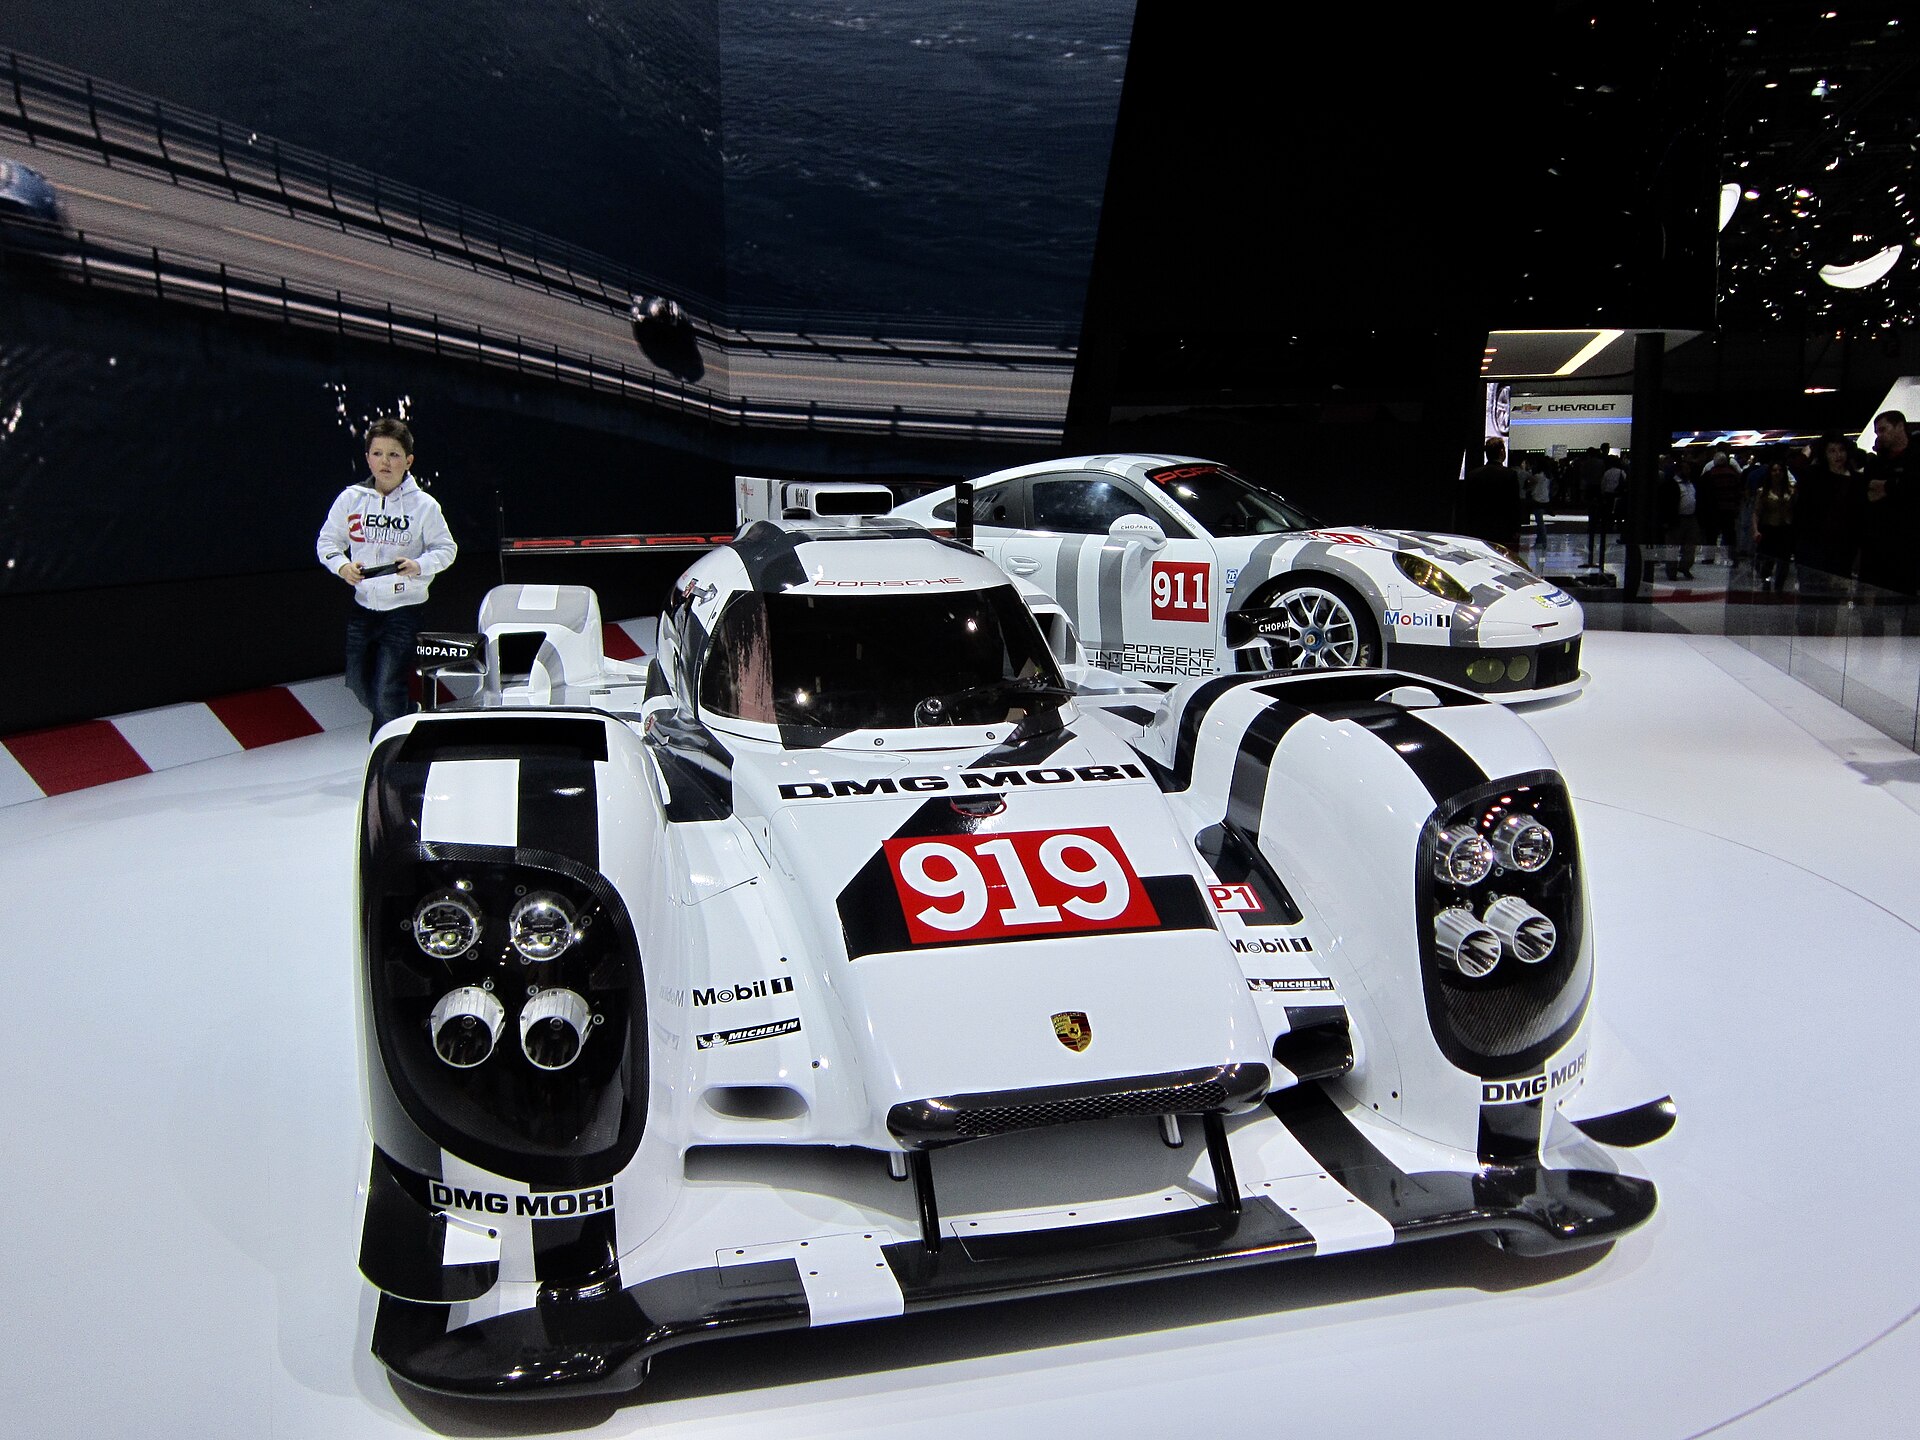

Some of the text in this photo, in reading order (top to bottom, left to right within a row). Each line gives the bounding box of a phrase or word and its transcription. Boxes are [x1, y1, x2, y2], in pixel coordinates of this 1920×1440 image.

[1547, 403, 1616, 412] CHEVROLET
[814, 577, 964, 587] PORSCHE
[1153, 571, 1207, 609] 911
[1385, 611, 1433, 626] Mobil
[1095, 651, 1213, 667] INTELLIGENT
[1123, 644, 1214, 658] PORSCHE
[778, 764, 1146, 799] DMG MORI
[899, 834, 1130, 931] 919
[1229, 938, 1290, 953] Mobil
[1272, 980, 1330, 988] MICHELIN
[692, 980, 767, 1007] Mobil
[728, 1020, 799, 1040] MICHELIN
[1482, 1076, 1548, 1101] DMG
[433, 1183, 614, 1216] DMG MORI
